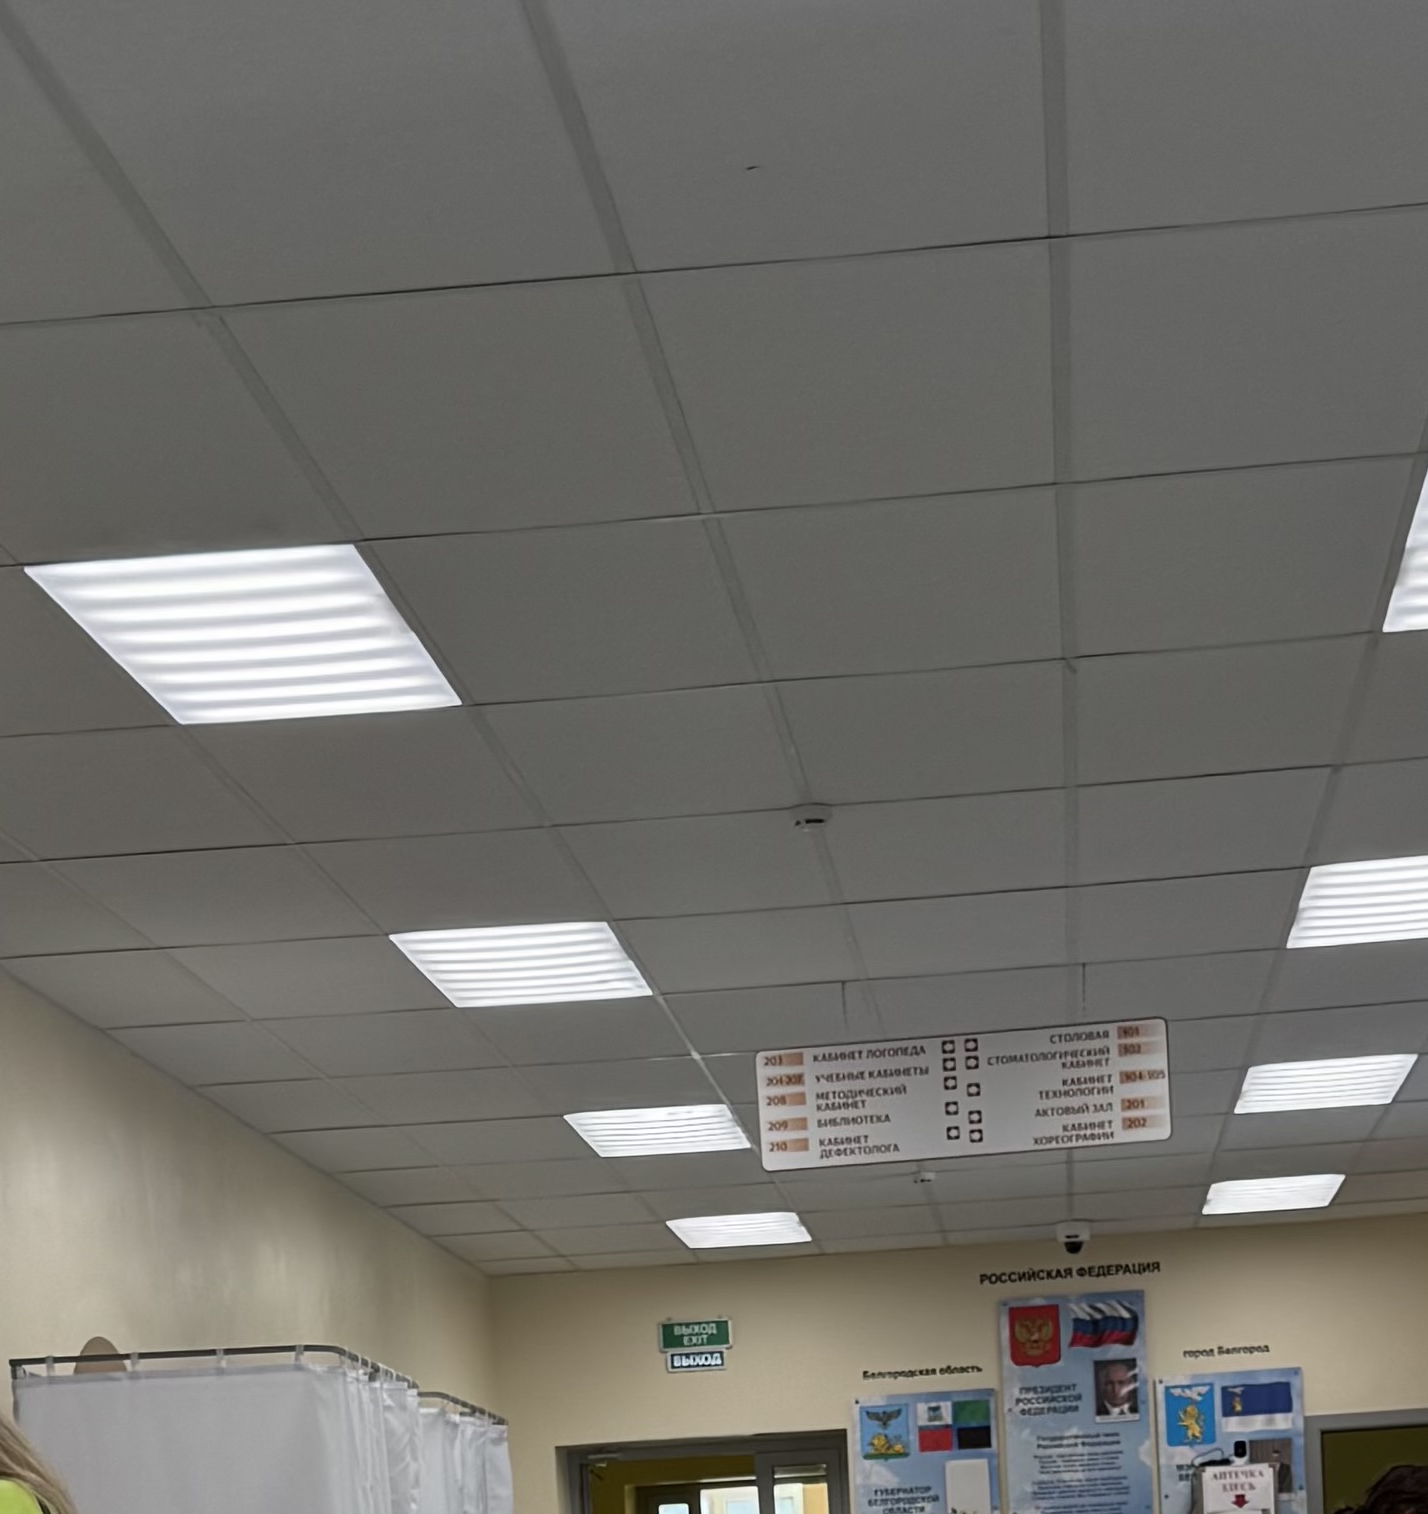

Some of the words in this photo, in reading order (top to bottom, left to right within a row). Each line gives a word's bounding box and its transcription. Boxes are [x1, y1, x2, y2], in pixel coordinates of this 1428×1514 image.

[1050, 1030, 1109, 1044] СТОЛОВАЯ
[813, 1051, 863, 1063] КАБИНЕТ
[866, 1046, 926, 1060] ЛОГОПЕДА
[987, 1045, 1110, 1066] СТОМАТОЛОГИЧЕСКИЙ
[1061, 1058, 1109, 1069] КАБИНЕТ
[815, 1070, 866, 1083] УЧЕБНЫЕ
[868, 1066, 929, 1080] КАБИНЕТЫ
[1062, 1074, 1112, 1087] КАБИНЕТ
[816, 1084, 907, 1101] МЕТОДИЧЕСКИЙ
[1039, 1085, 1114, 1100] ТЕХНОЛОГИИ
[816, 1100, 866, 1112] КАБИНЕТ
[1035, 1103, 1089, 1118] АКТОВЫЙ
[1092, 1103, 1113, 1114] ЗАЛ
[768, 1121, 788, 1132] 209
[817, 1114, 891, 1128] БИБЛИОТЕКА
[1062, 1120, 1113, 1133] КАБИНЕТ
[1127, 1118, 1147, 1129] 202
[819, 1135, 869, 1147] КАБИНЕТ
[1033, 1131, 1114, 1146] ХОРЕОГРАФИИ
[820, 1144, 900, 1159] ДЕФЕКТОЛОГА
[979, 1267, 1073, 1285] РОССИЙСКАЯ
[1076, 1261, 1161, 1278] ФЕДЕРАЦИЯ
[674, 1323, 717, 1336] ВЫХОД
[1183, 1348, 1215, 1359] город
[1217, 1344, 1270, 1357] Белгород
[673, 1353, 722, 1367] ВЫХОД
[862, 1367, 938, 1380] Белгородская
[939, 1365, 983, 1376] область
[1212, 1469, 1264, 1482] АПТЕЧКА
